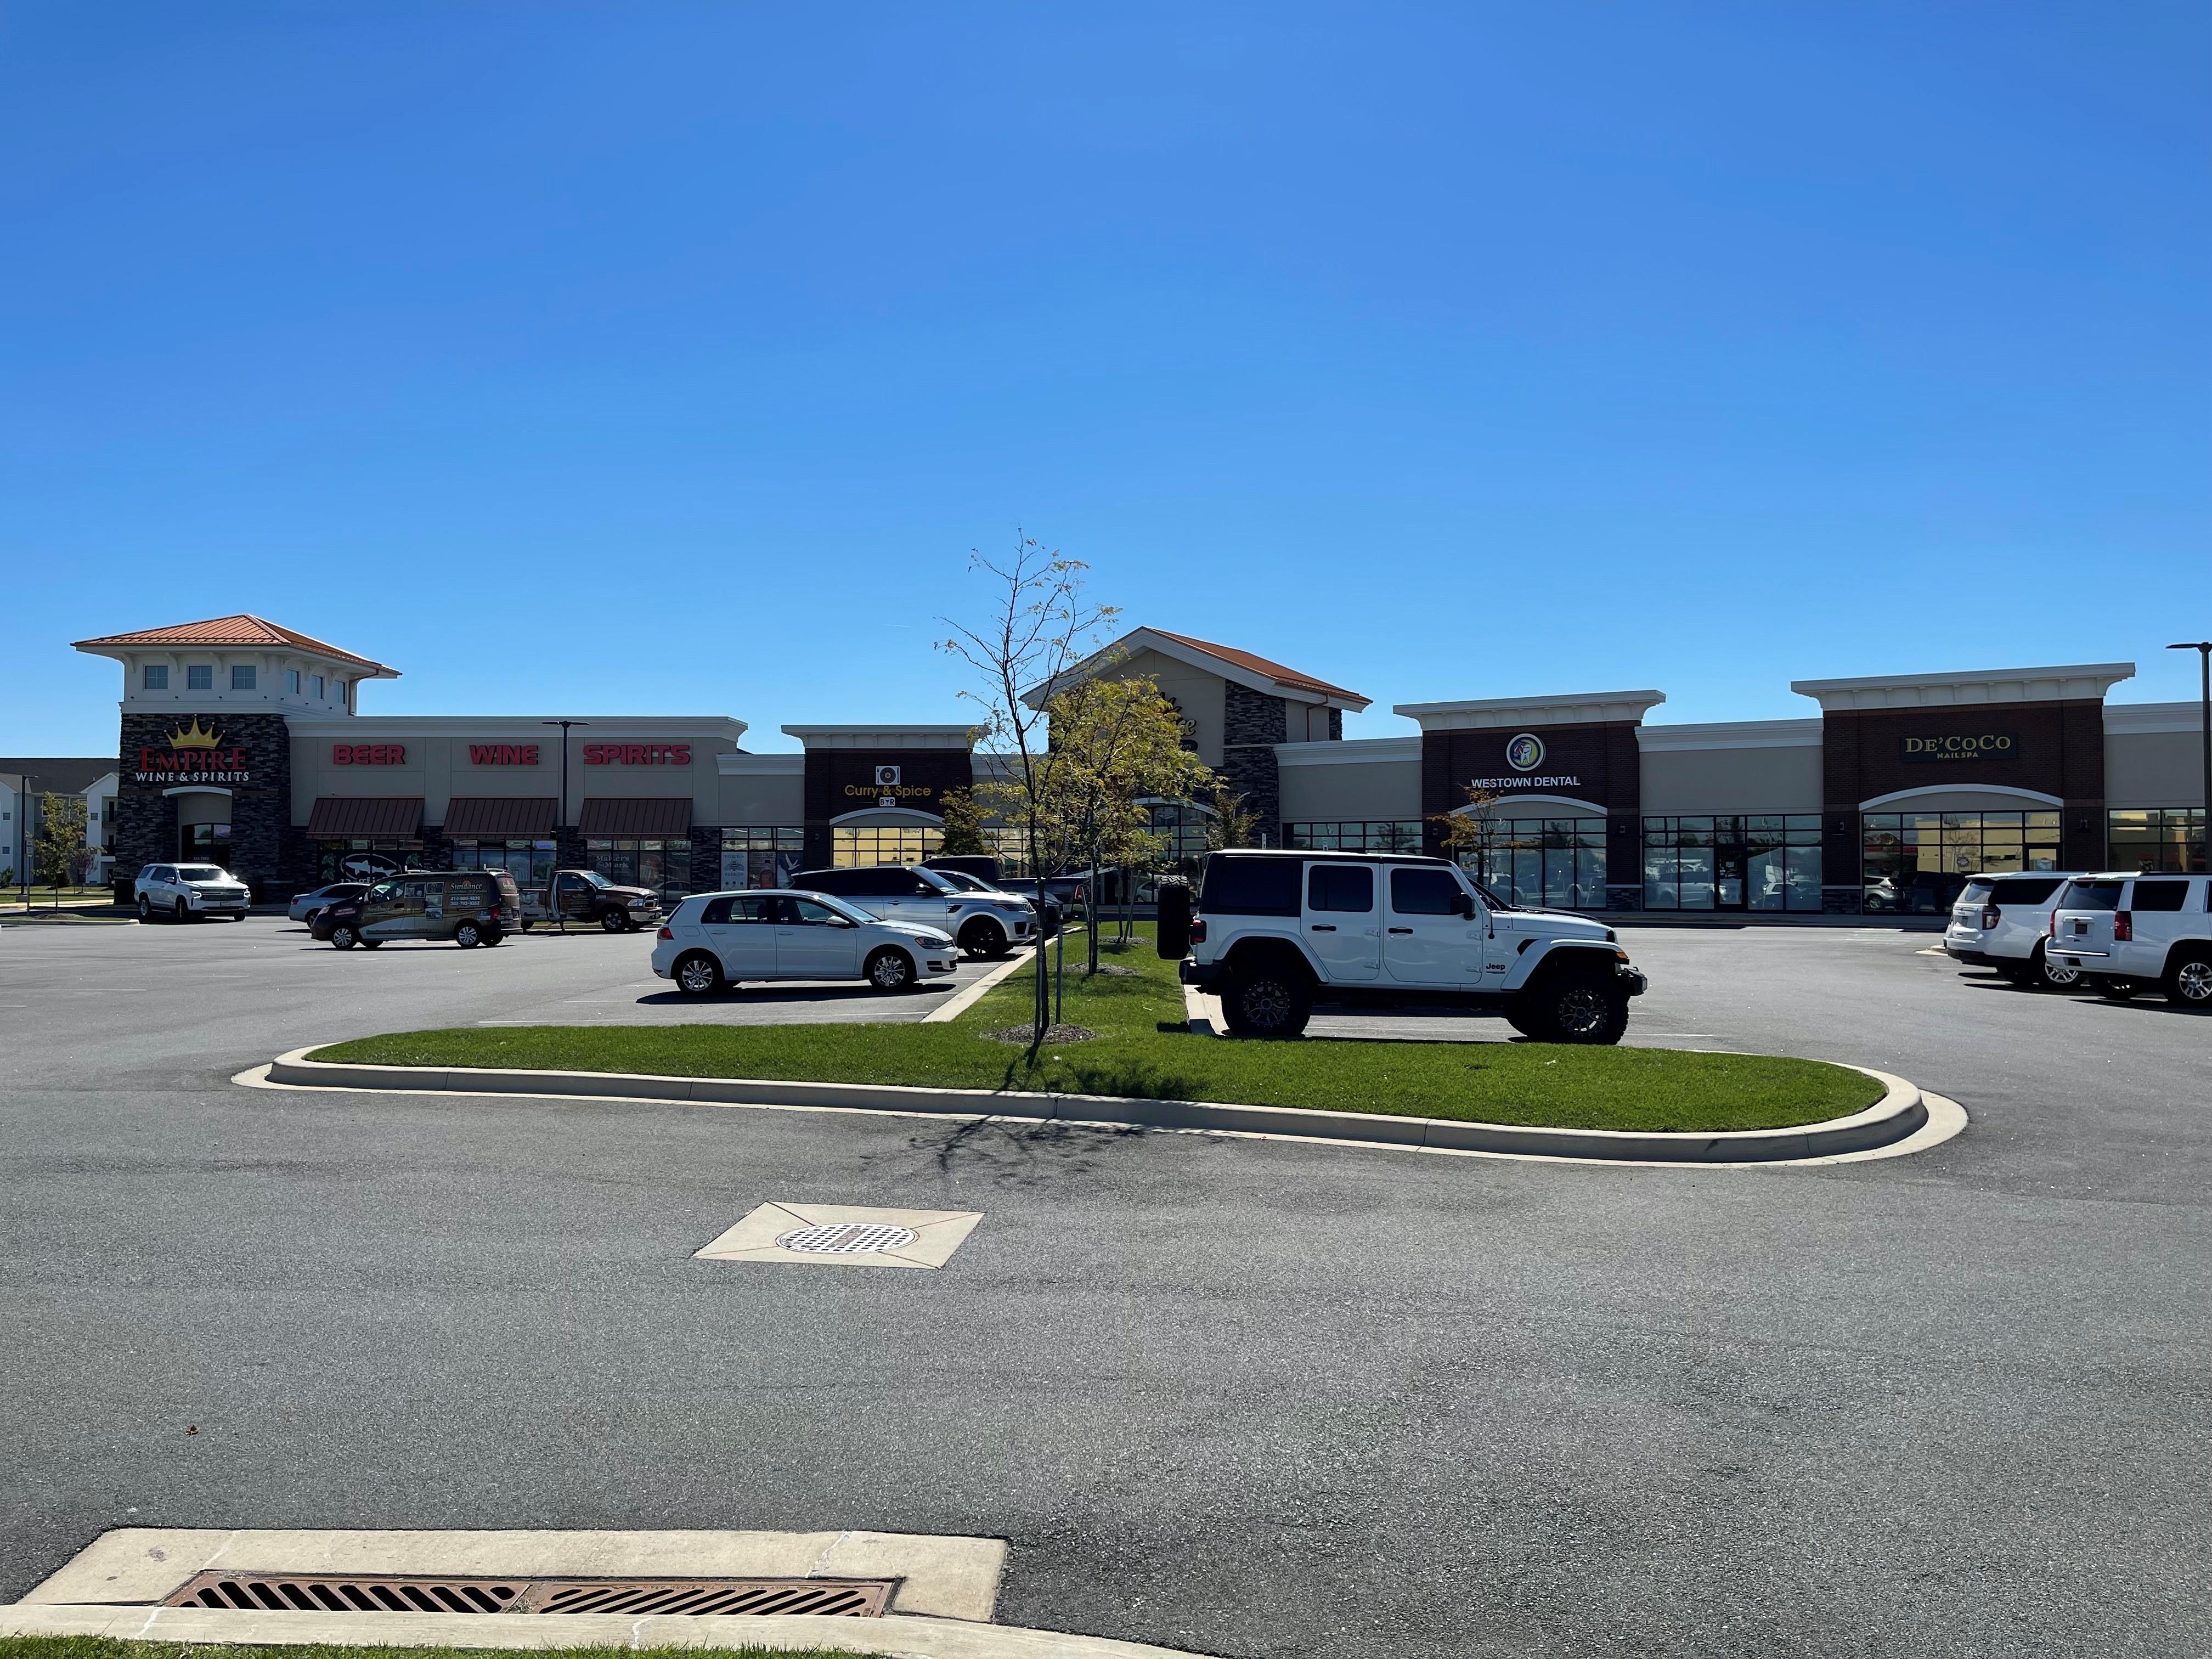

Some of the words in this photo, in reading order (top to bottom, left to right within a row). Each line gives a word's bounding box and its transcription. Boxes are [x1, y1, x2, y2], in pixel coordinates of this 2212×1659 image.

[140, 747, 246, 771] EMPIRE
[333, 744, 405, 765] BEER
[469, 744, 539, 765] WINE
[582, 744, 691, 765] SPIRITS
[135, 772, 174, 782] WINE
[179, 772, 189, 782] &
[193, 771, 249, 782] SPIRITS
[1471, 777, 1531, 788] WESTOWN
[1534, 776, 1581, 787] DENTAL
[844, 785, 879, 799] Curry
[882, 785, 891, 796] &
[895, 785, 932, 799] Spice
[450, 882, 483, 891] Sundance
